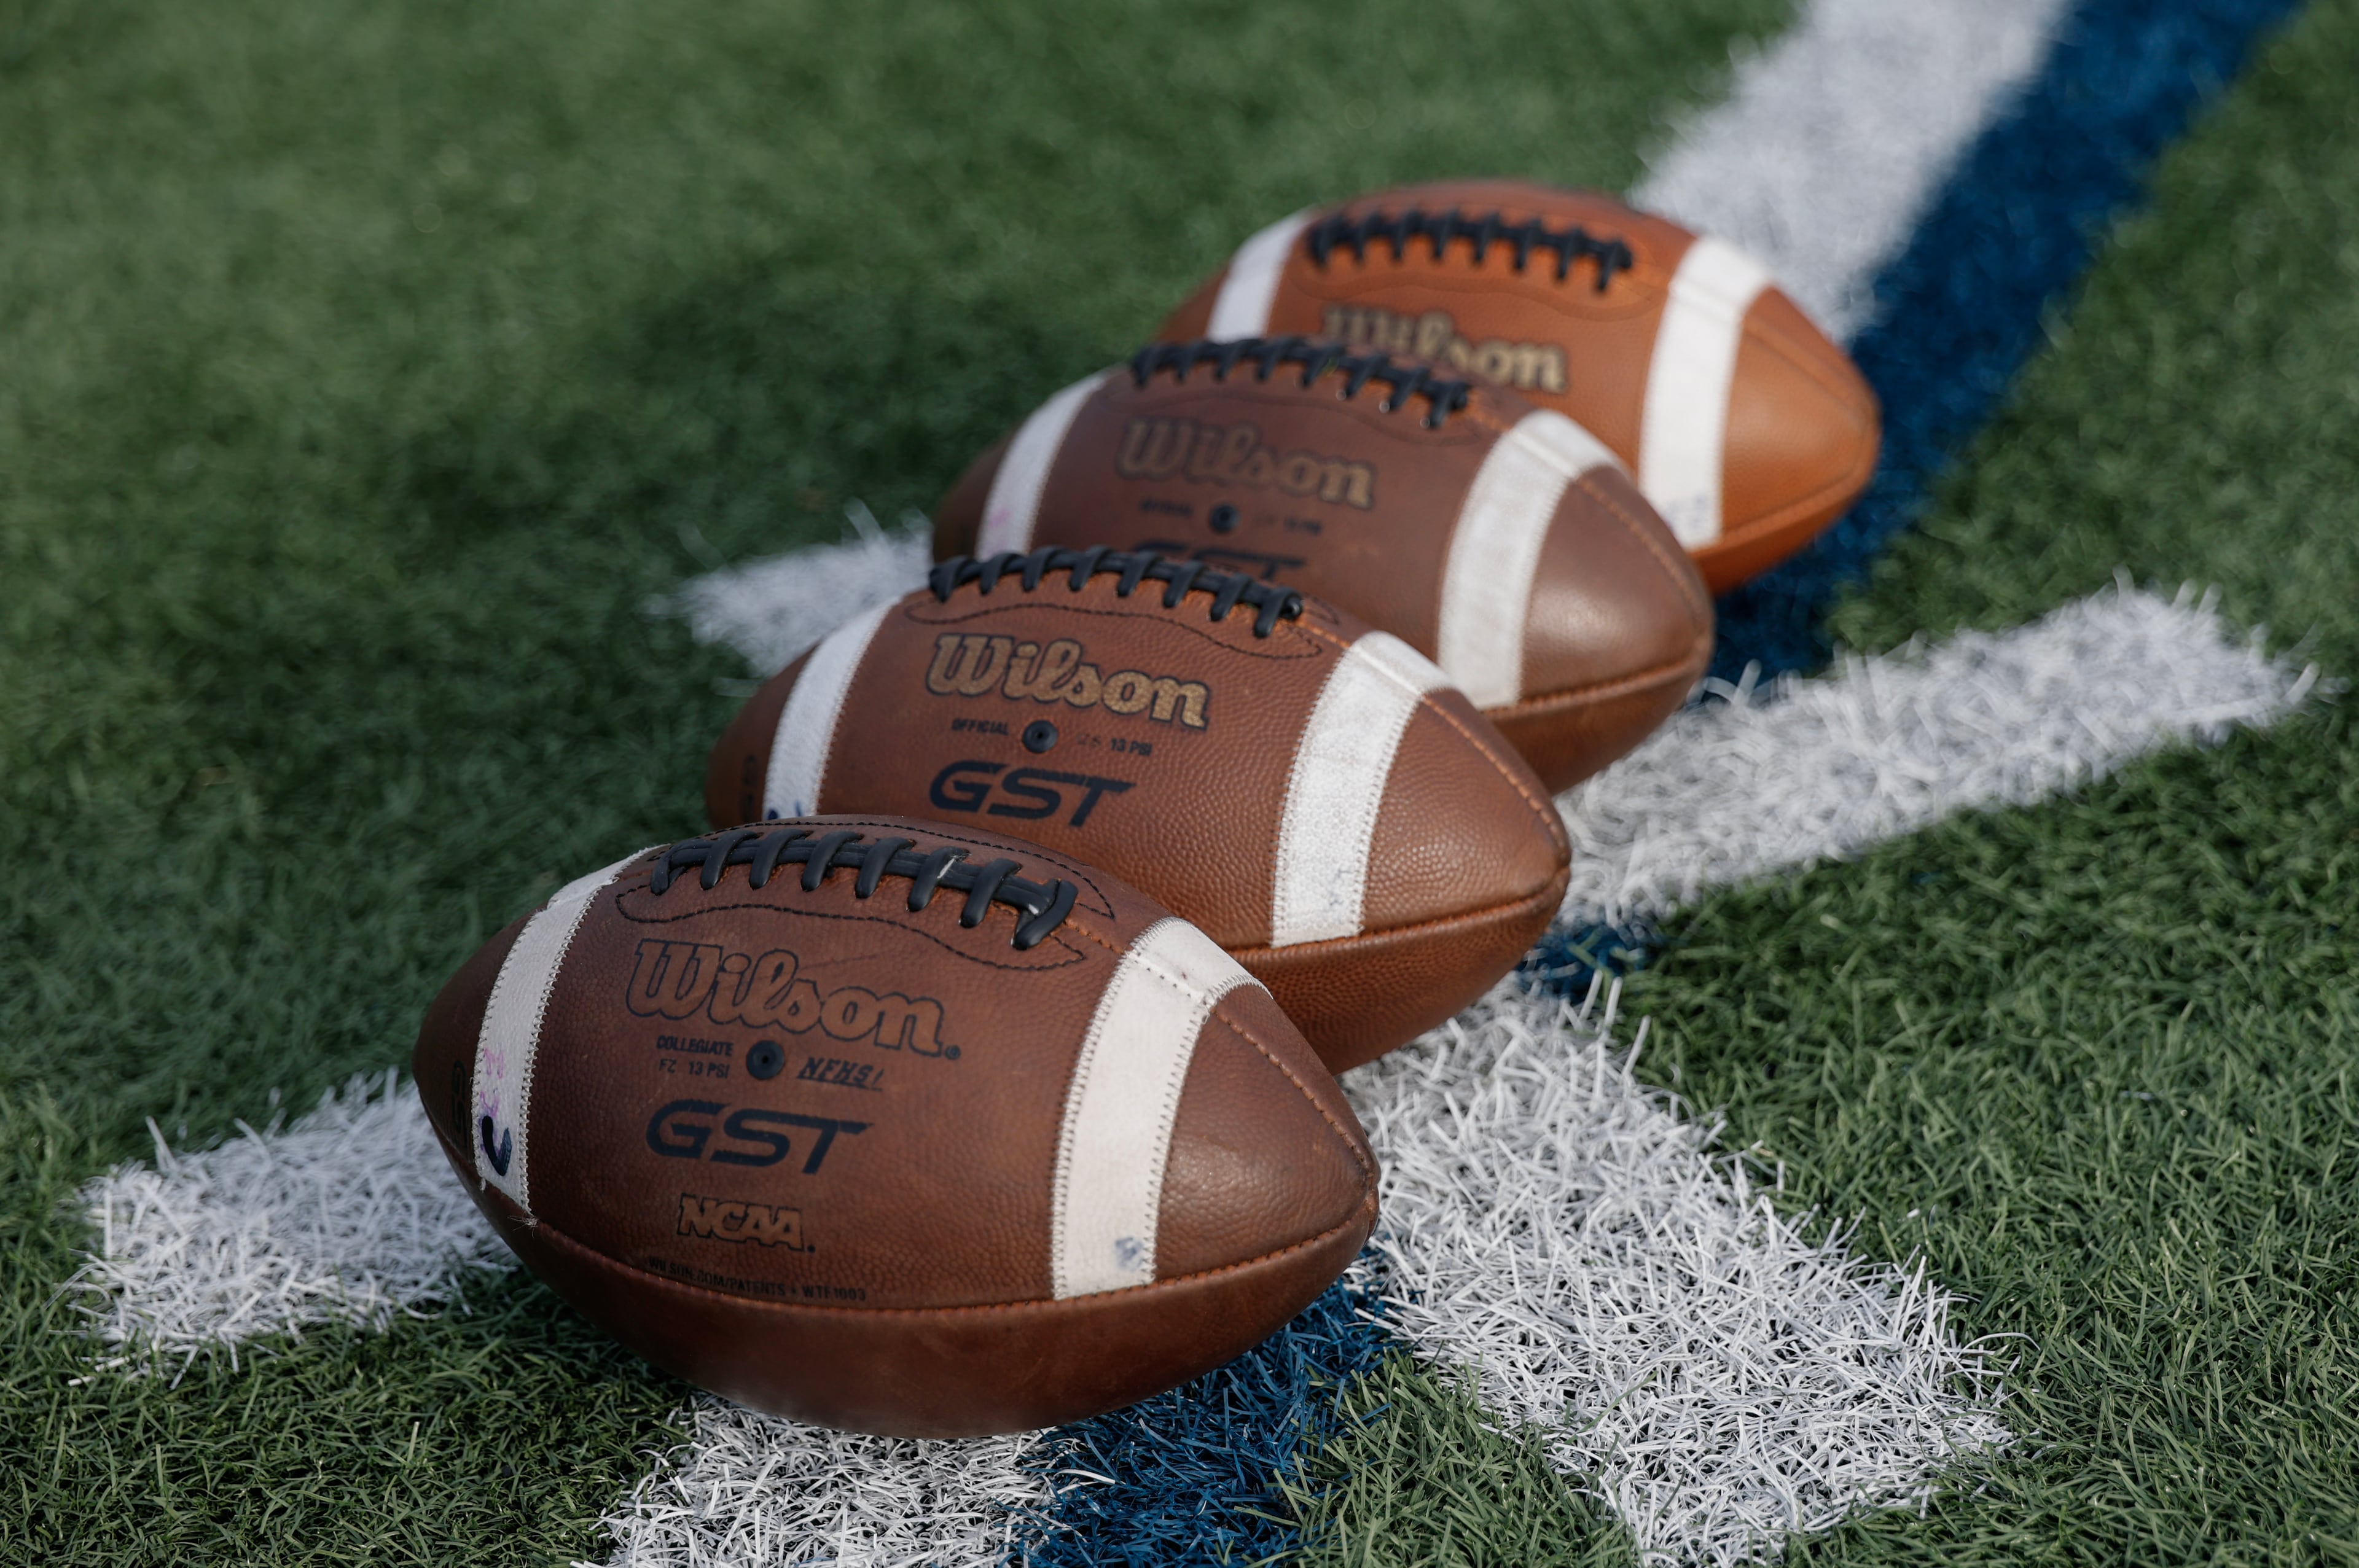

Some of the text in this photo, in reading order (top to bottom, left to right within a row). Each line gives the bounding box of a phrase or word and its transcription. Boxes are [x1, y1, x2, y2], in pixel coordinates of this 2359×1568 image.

[1321, 303, 1567, 394] Wilson
[1116, 416, 1377, 509] Wilson
[925, 633, 1211, 730] Wilson
[952, 717, 1009, 736] OFFICIAL
[1111, 738, 1126, 752] 13
[929, 760, 1136, 827] GST
[625, 938, 945, 1056] Wilson
[656, 1035, 734, 1057] COLLEGIATE
[688, 1061, 703, 1075] 13
[706, 1062, 730, 1079] PSI
[646, 1099, 875, 1174] GST
[676, 1193, 805, 1252] NCAA
